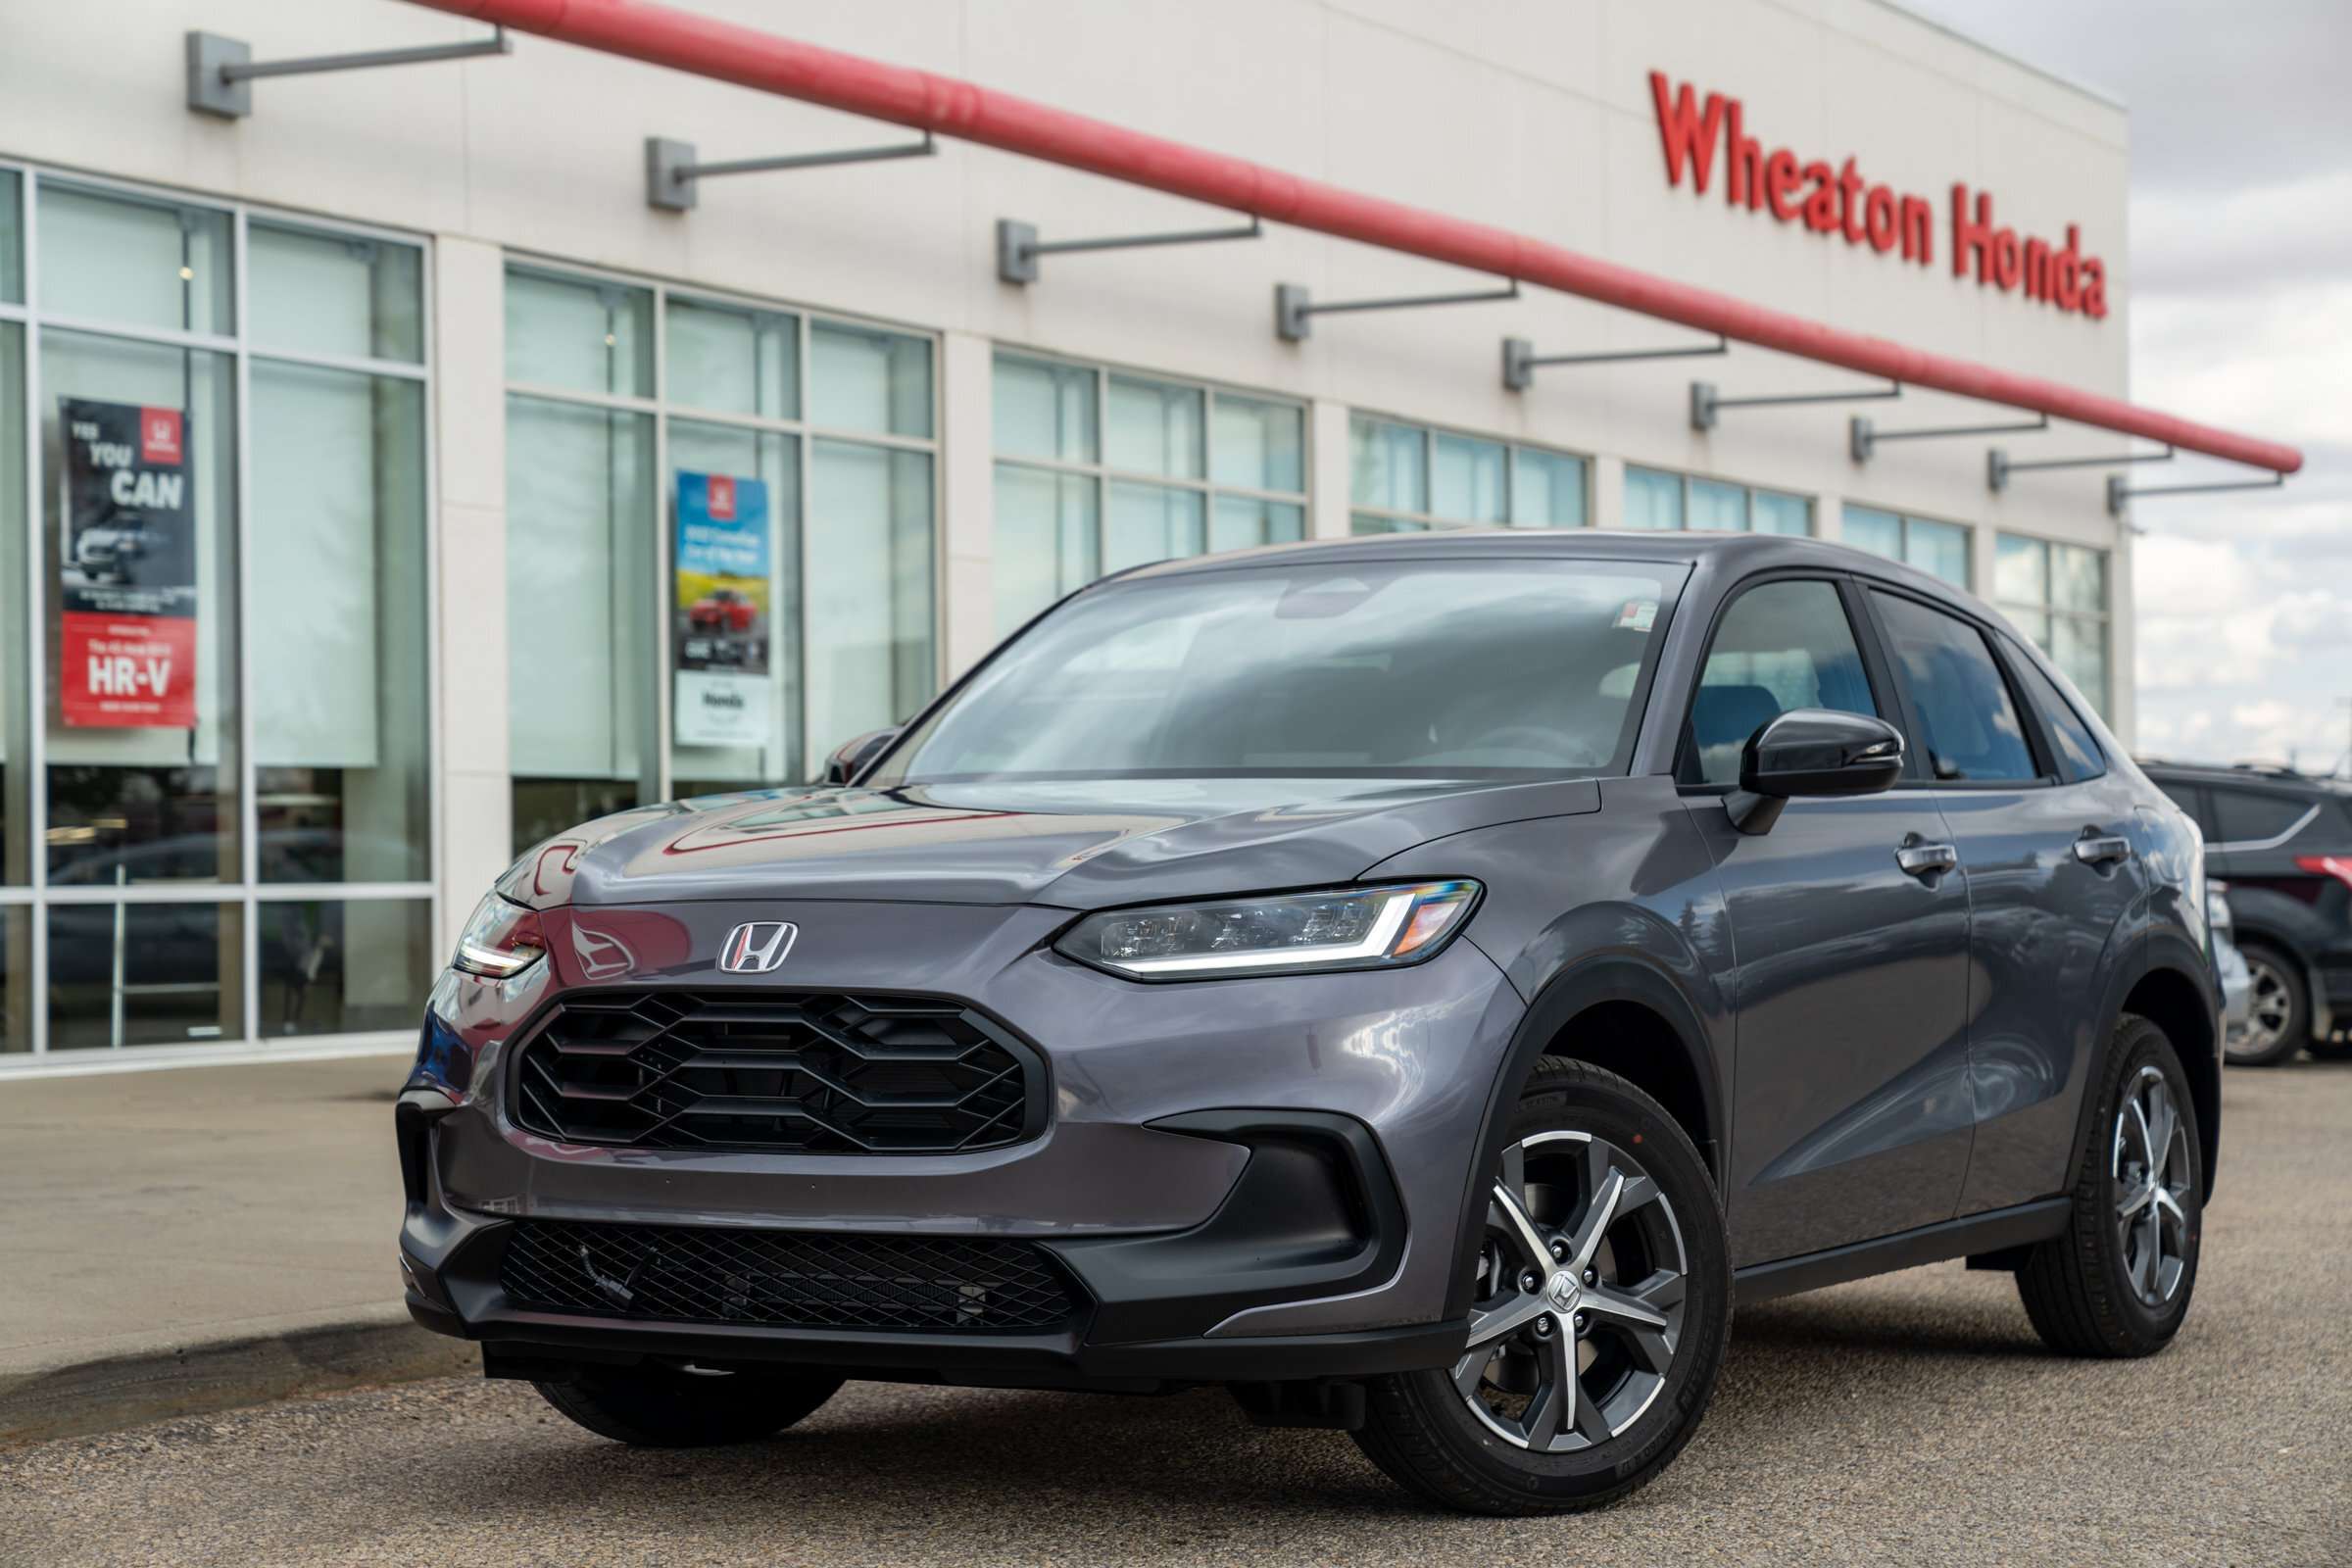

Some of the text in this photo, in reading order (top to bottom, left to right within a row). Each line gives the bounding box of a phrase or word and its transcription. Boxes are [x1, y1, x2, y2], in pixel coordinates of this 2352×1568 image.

[1647, 70, 2109, 320] Wheaton Honda
[90, 442, 132, 467] YOU
[111, 469, 183, 510] CAN
[88, 657, 172, 697] HR-V
